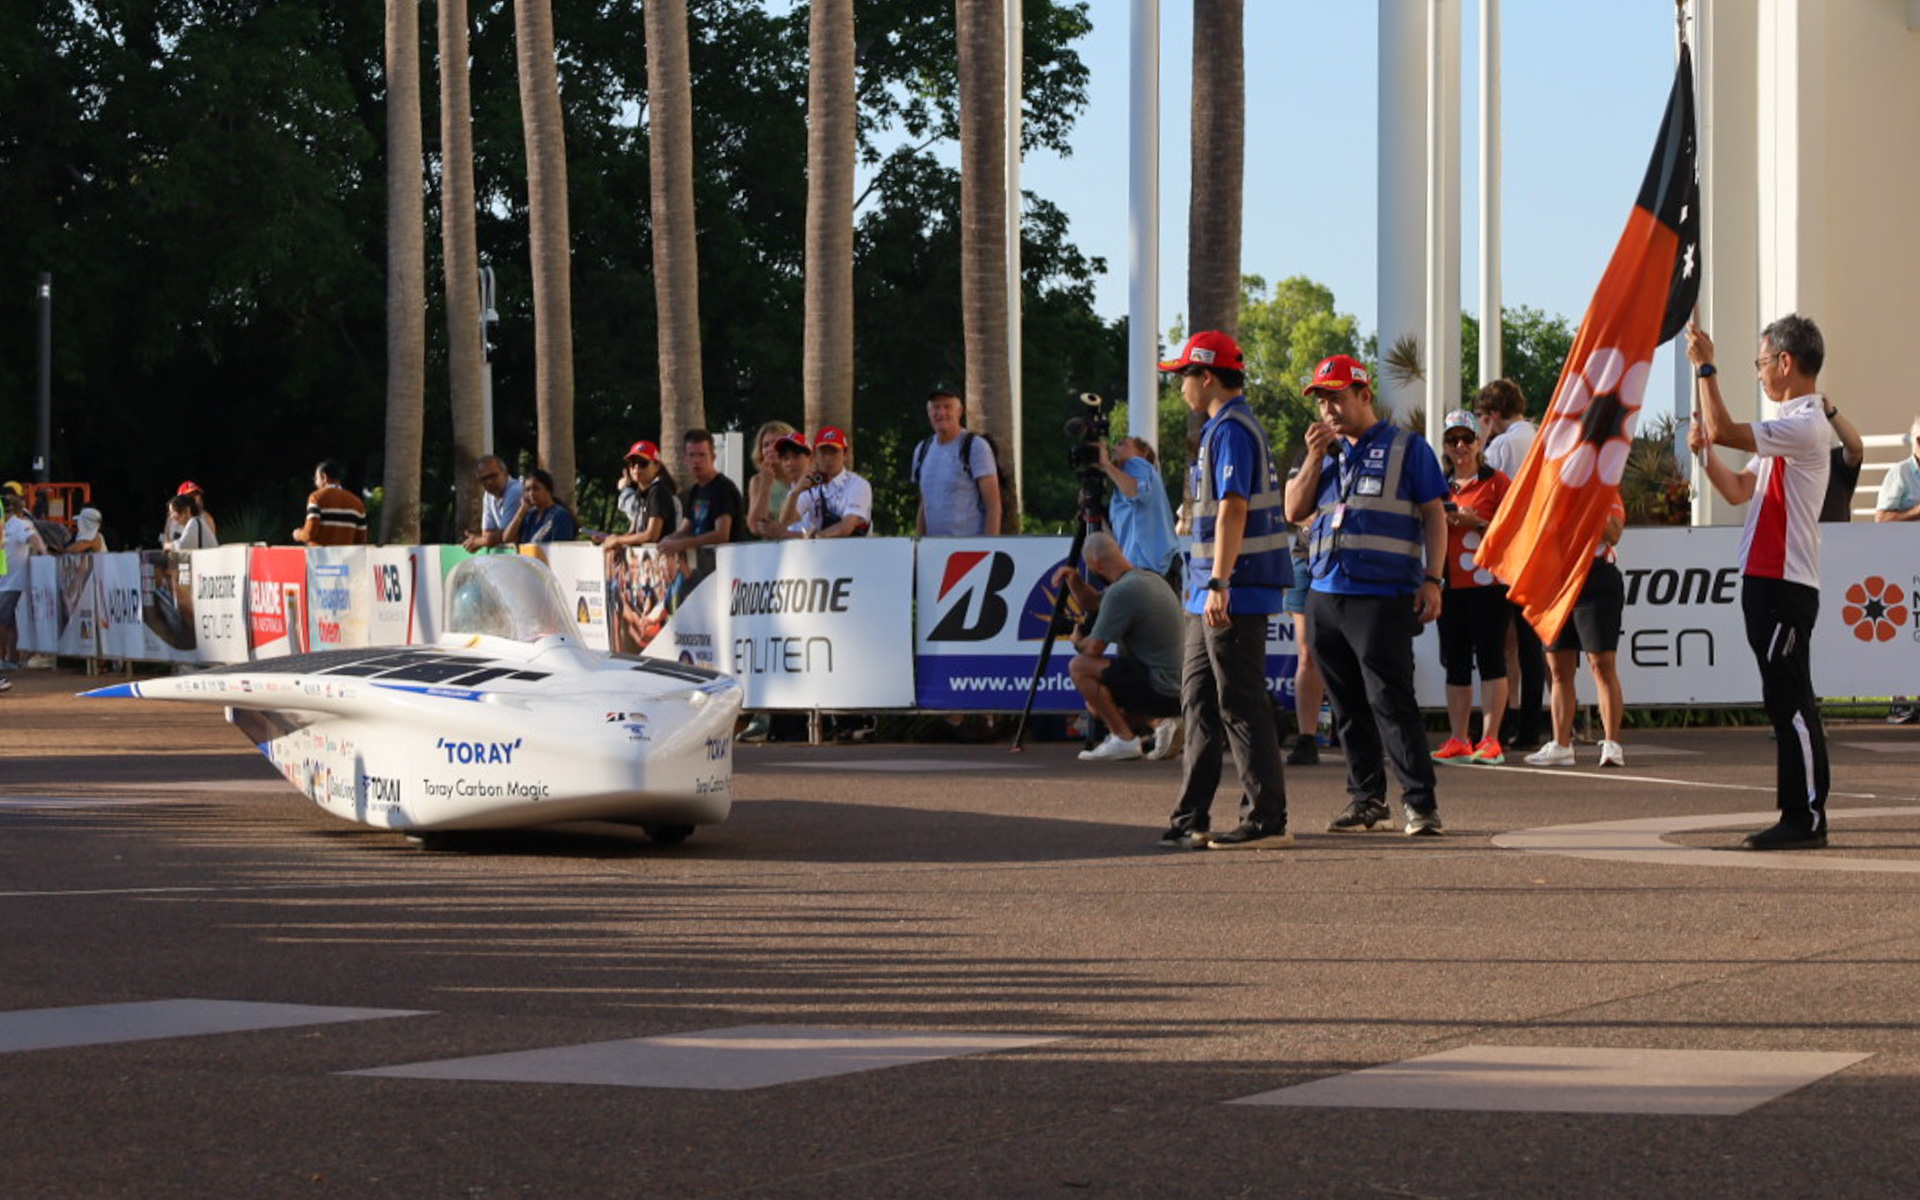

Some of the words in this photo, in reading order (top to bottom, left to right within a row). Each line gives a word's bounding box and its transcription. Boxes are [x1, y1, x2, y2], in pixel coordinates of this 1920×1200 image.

[730, 577, 853, 616] BRIDGESTONE
[735, 637, 833, 673] ENLITEN
[423, 779, 453, 799] Toray
[456, 778, 503, 796] Carbon
[507, 781, 549, 801] Magic
